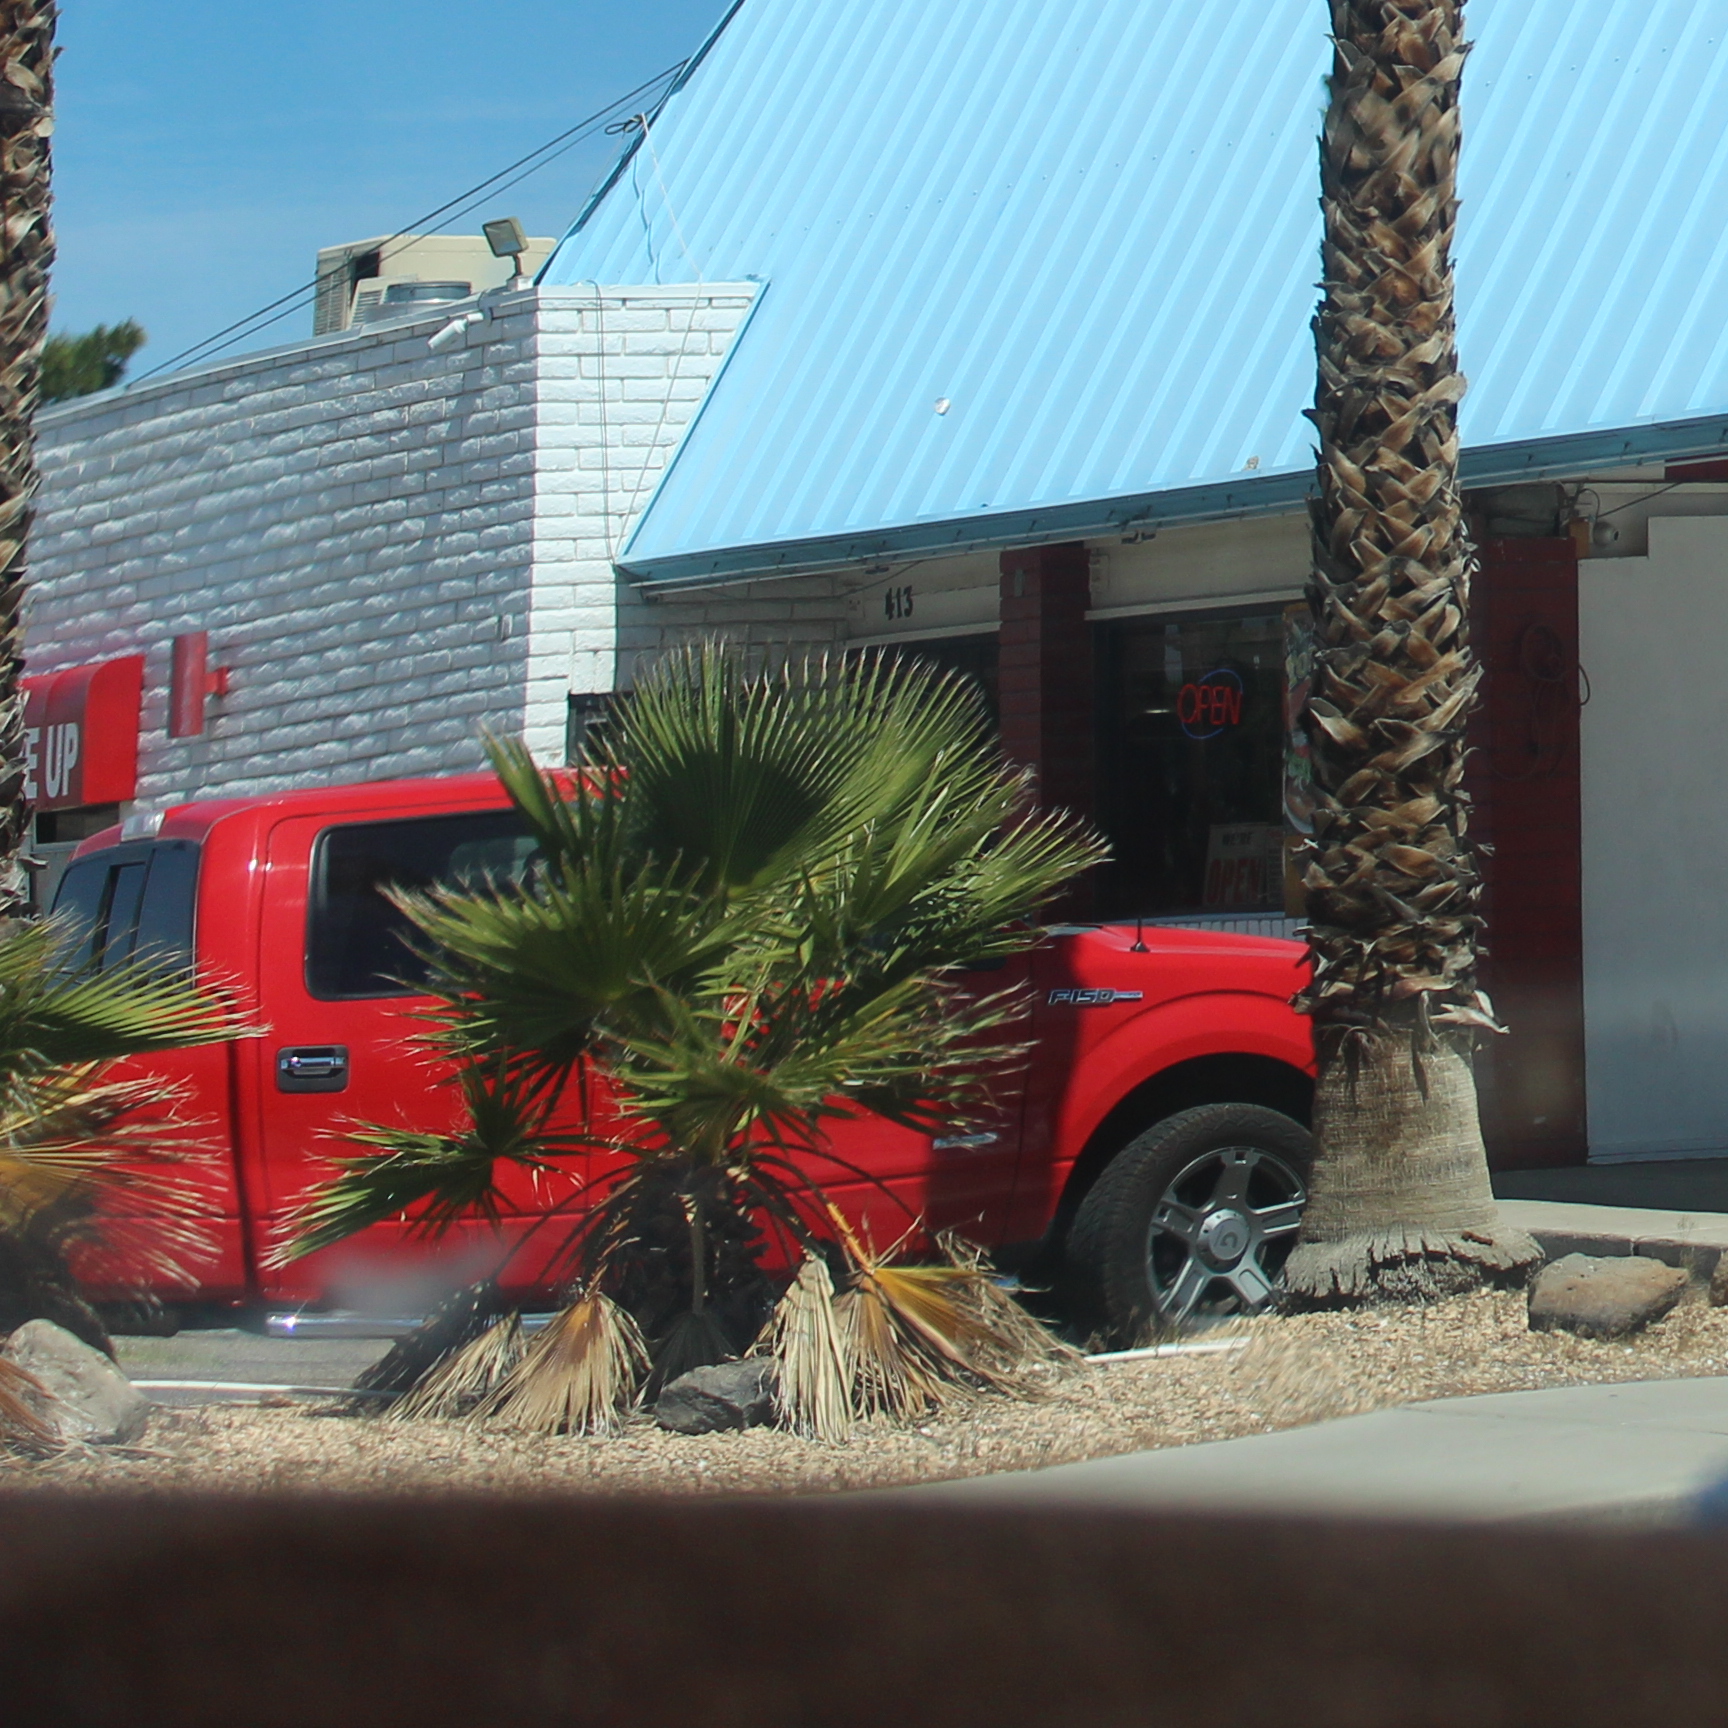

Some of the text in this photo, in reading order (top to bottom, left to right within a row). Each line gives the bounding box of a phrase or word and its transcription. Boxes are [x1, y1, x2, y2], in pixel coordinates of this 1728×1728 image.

[885, 585, 913, 621] 413
[1177, 683, 1243, 725] OPEN
[45, 722, 79, 799] UP
[1207, 857, 1260, 904] OPEN
